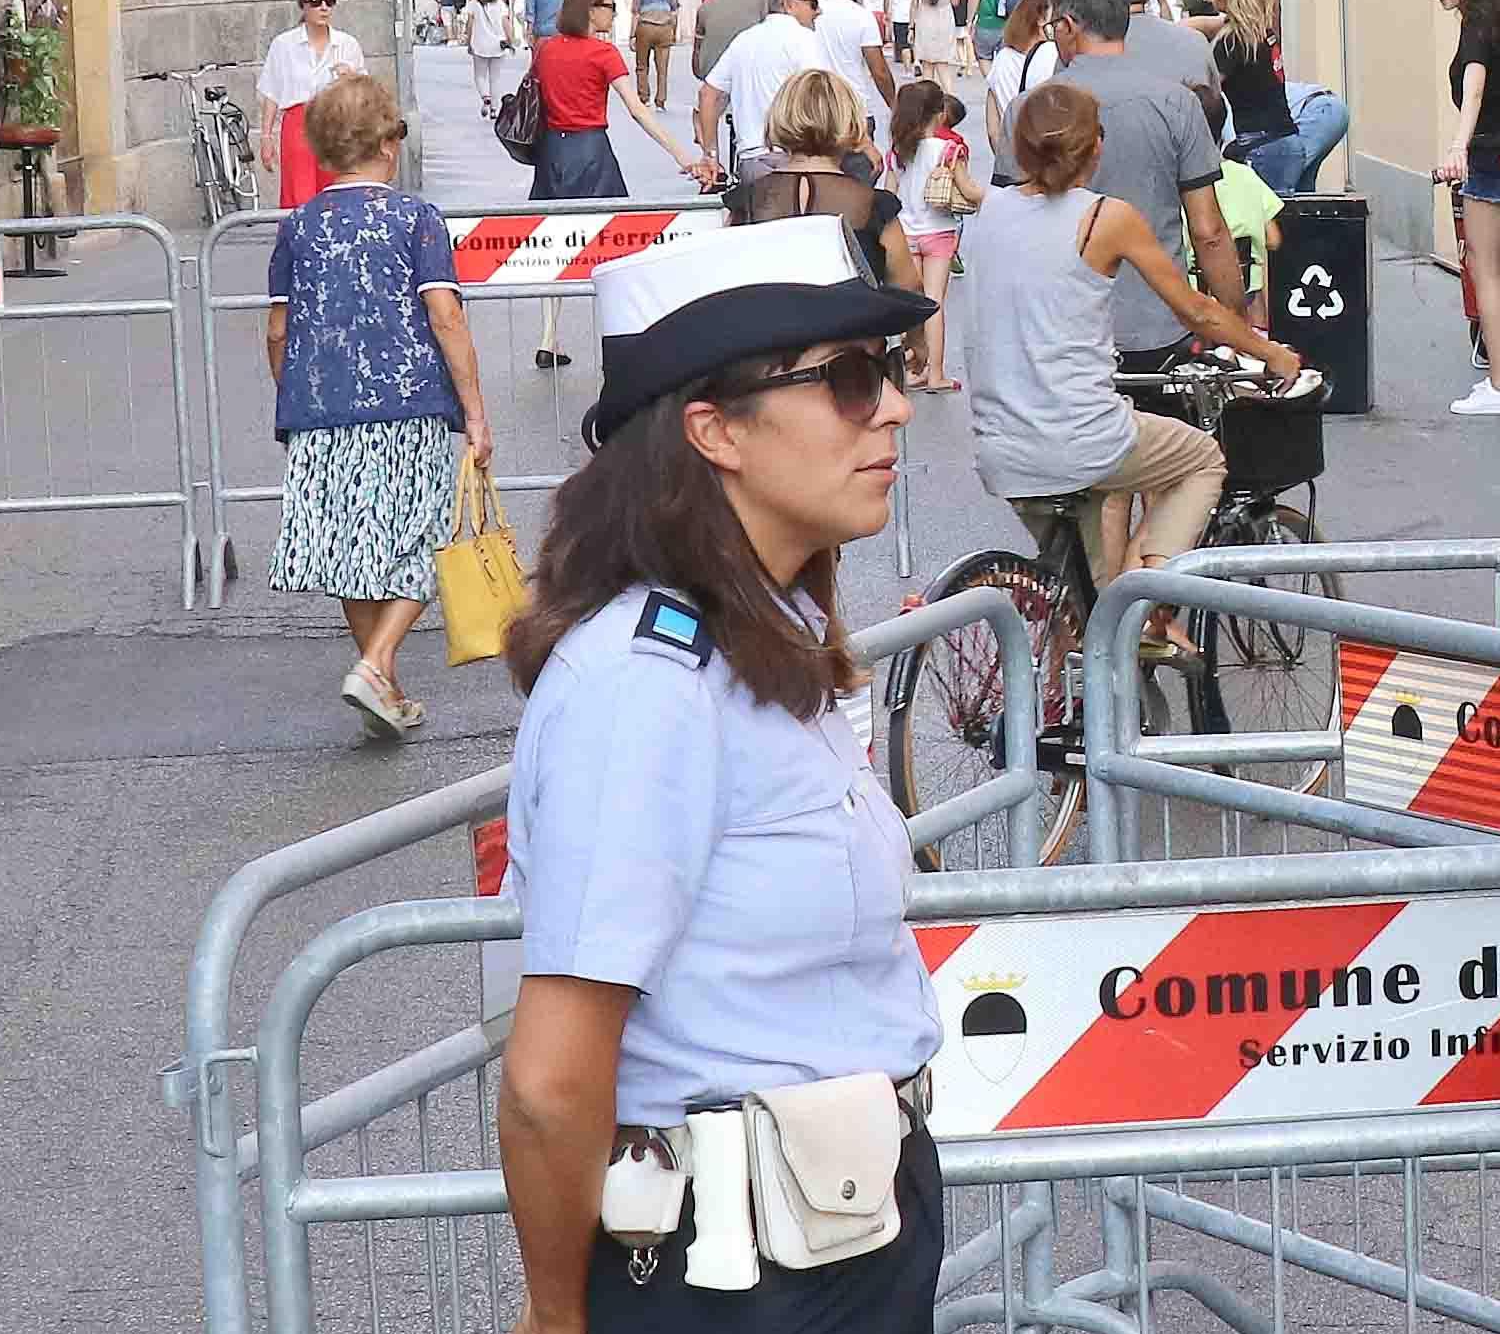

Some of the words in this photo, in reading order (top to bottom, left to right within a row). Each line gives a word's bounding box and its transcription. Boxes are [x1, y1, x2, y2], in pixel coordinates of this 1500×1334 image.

[452, 232, 553, 251] Comune
[565, 229, 587, 248] di
[1099, 959, 1421, 1021] Comune
[1238, 1029, 1410, 1071] Servizio
